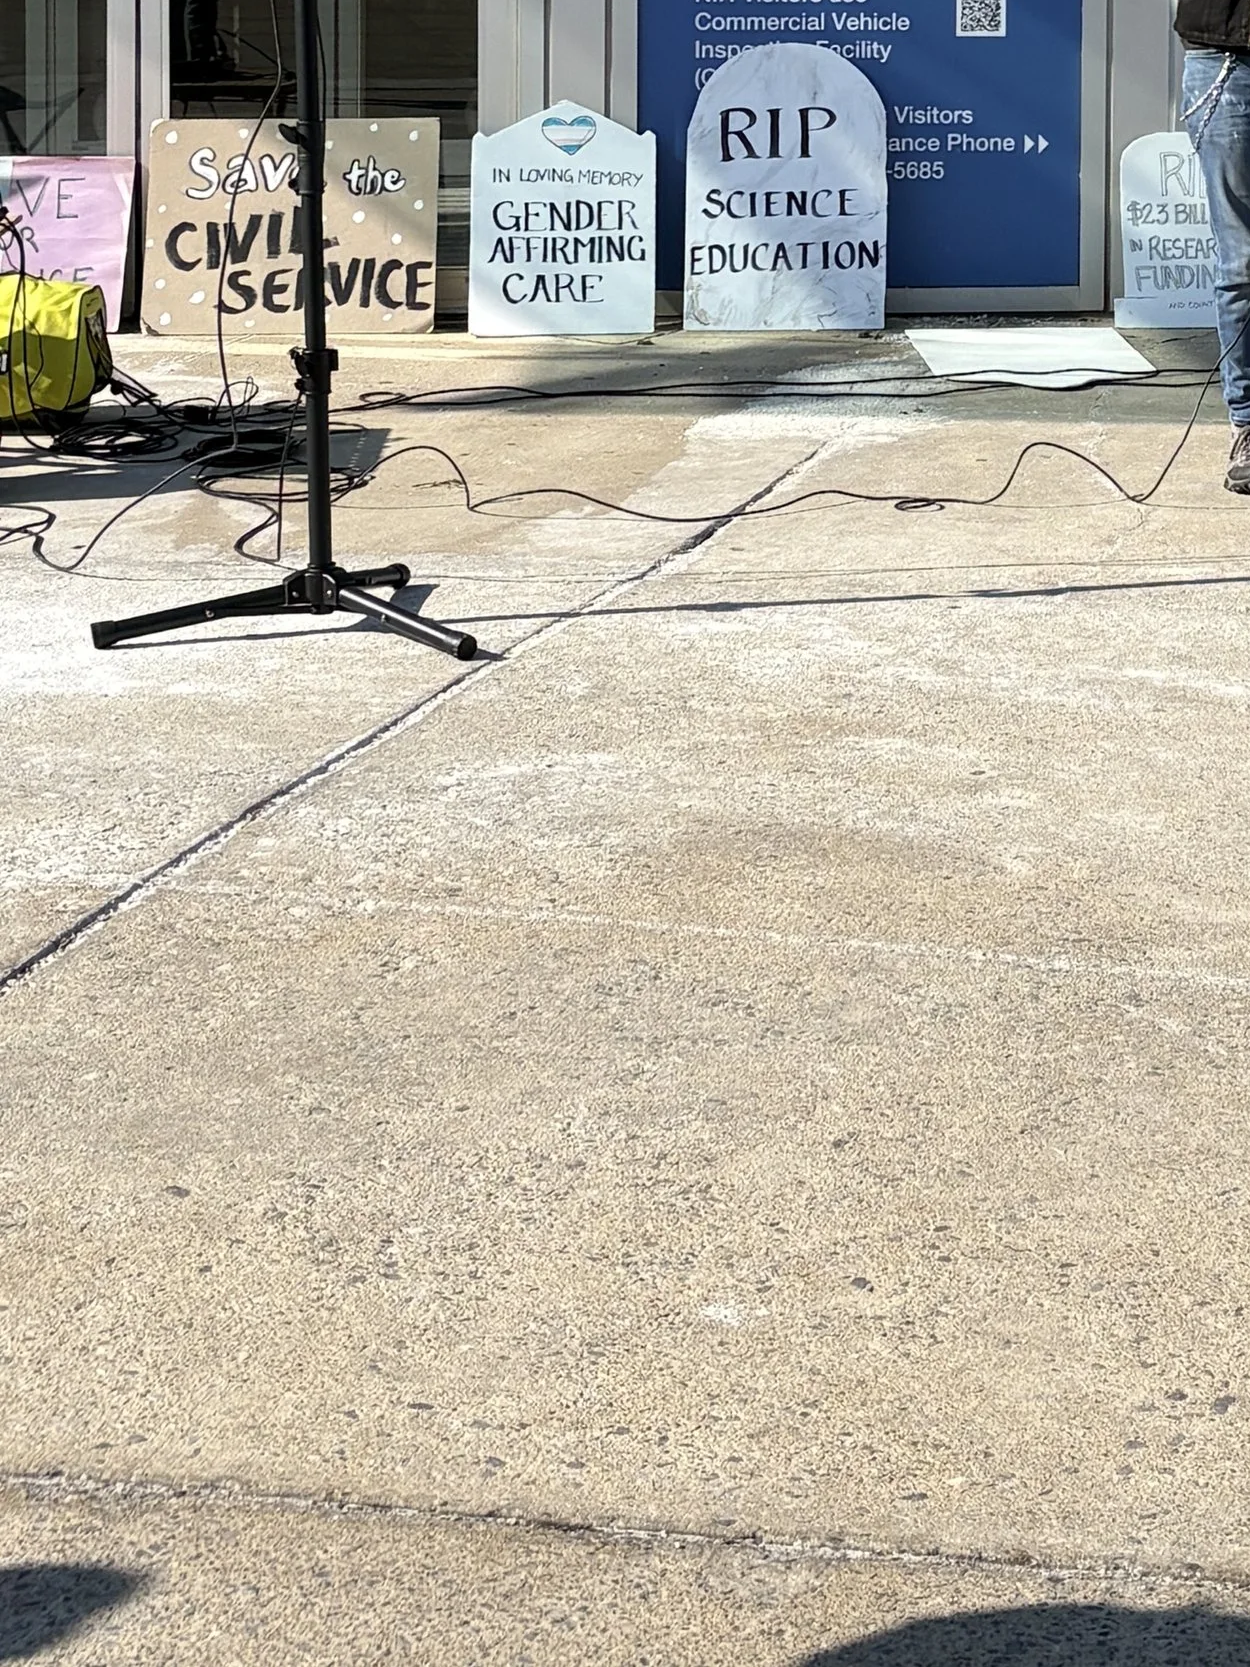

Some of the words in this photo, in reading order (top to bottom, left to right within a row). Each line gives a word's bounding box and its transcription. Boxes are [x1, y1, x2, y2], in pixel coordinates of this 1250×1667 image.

[695, 12, 825, 31] Commercial
[832, 12, 910, 31] Vehicle
[894, 106, 973, 124] Visitors
[719, 107, 837, 162] RIP
[947, 133, 1015, 152] Phone
[185, 147, 300, 200] Sav
[343, 155, 406, 196] the
[493, 168, 510, 183] IN
[519, 168, 573, 184] LOVING
[578, 169, 643, 187] MEMORY
[492, 199, 639, 232] GENDER
[702, 188, 860, 219] SCIENCE
[1126, 200, 1169, 227] $23
[487, 235, 646, 265] AFFIRMING
[690, 240, 881, 276] EDUCATION
[1129, 238, 1143, 253] IN
[502, 273, 604, 304] CARE
